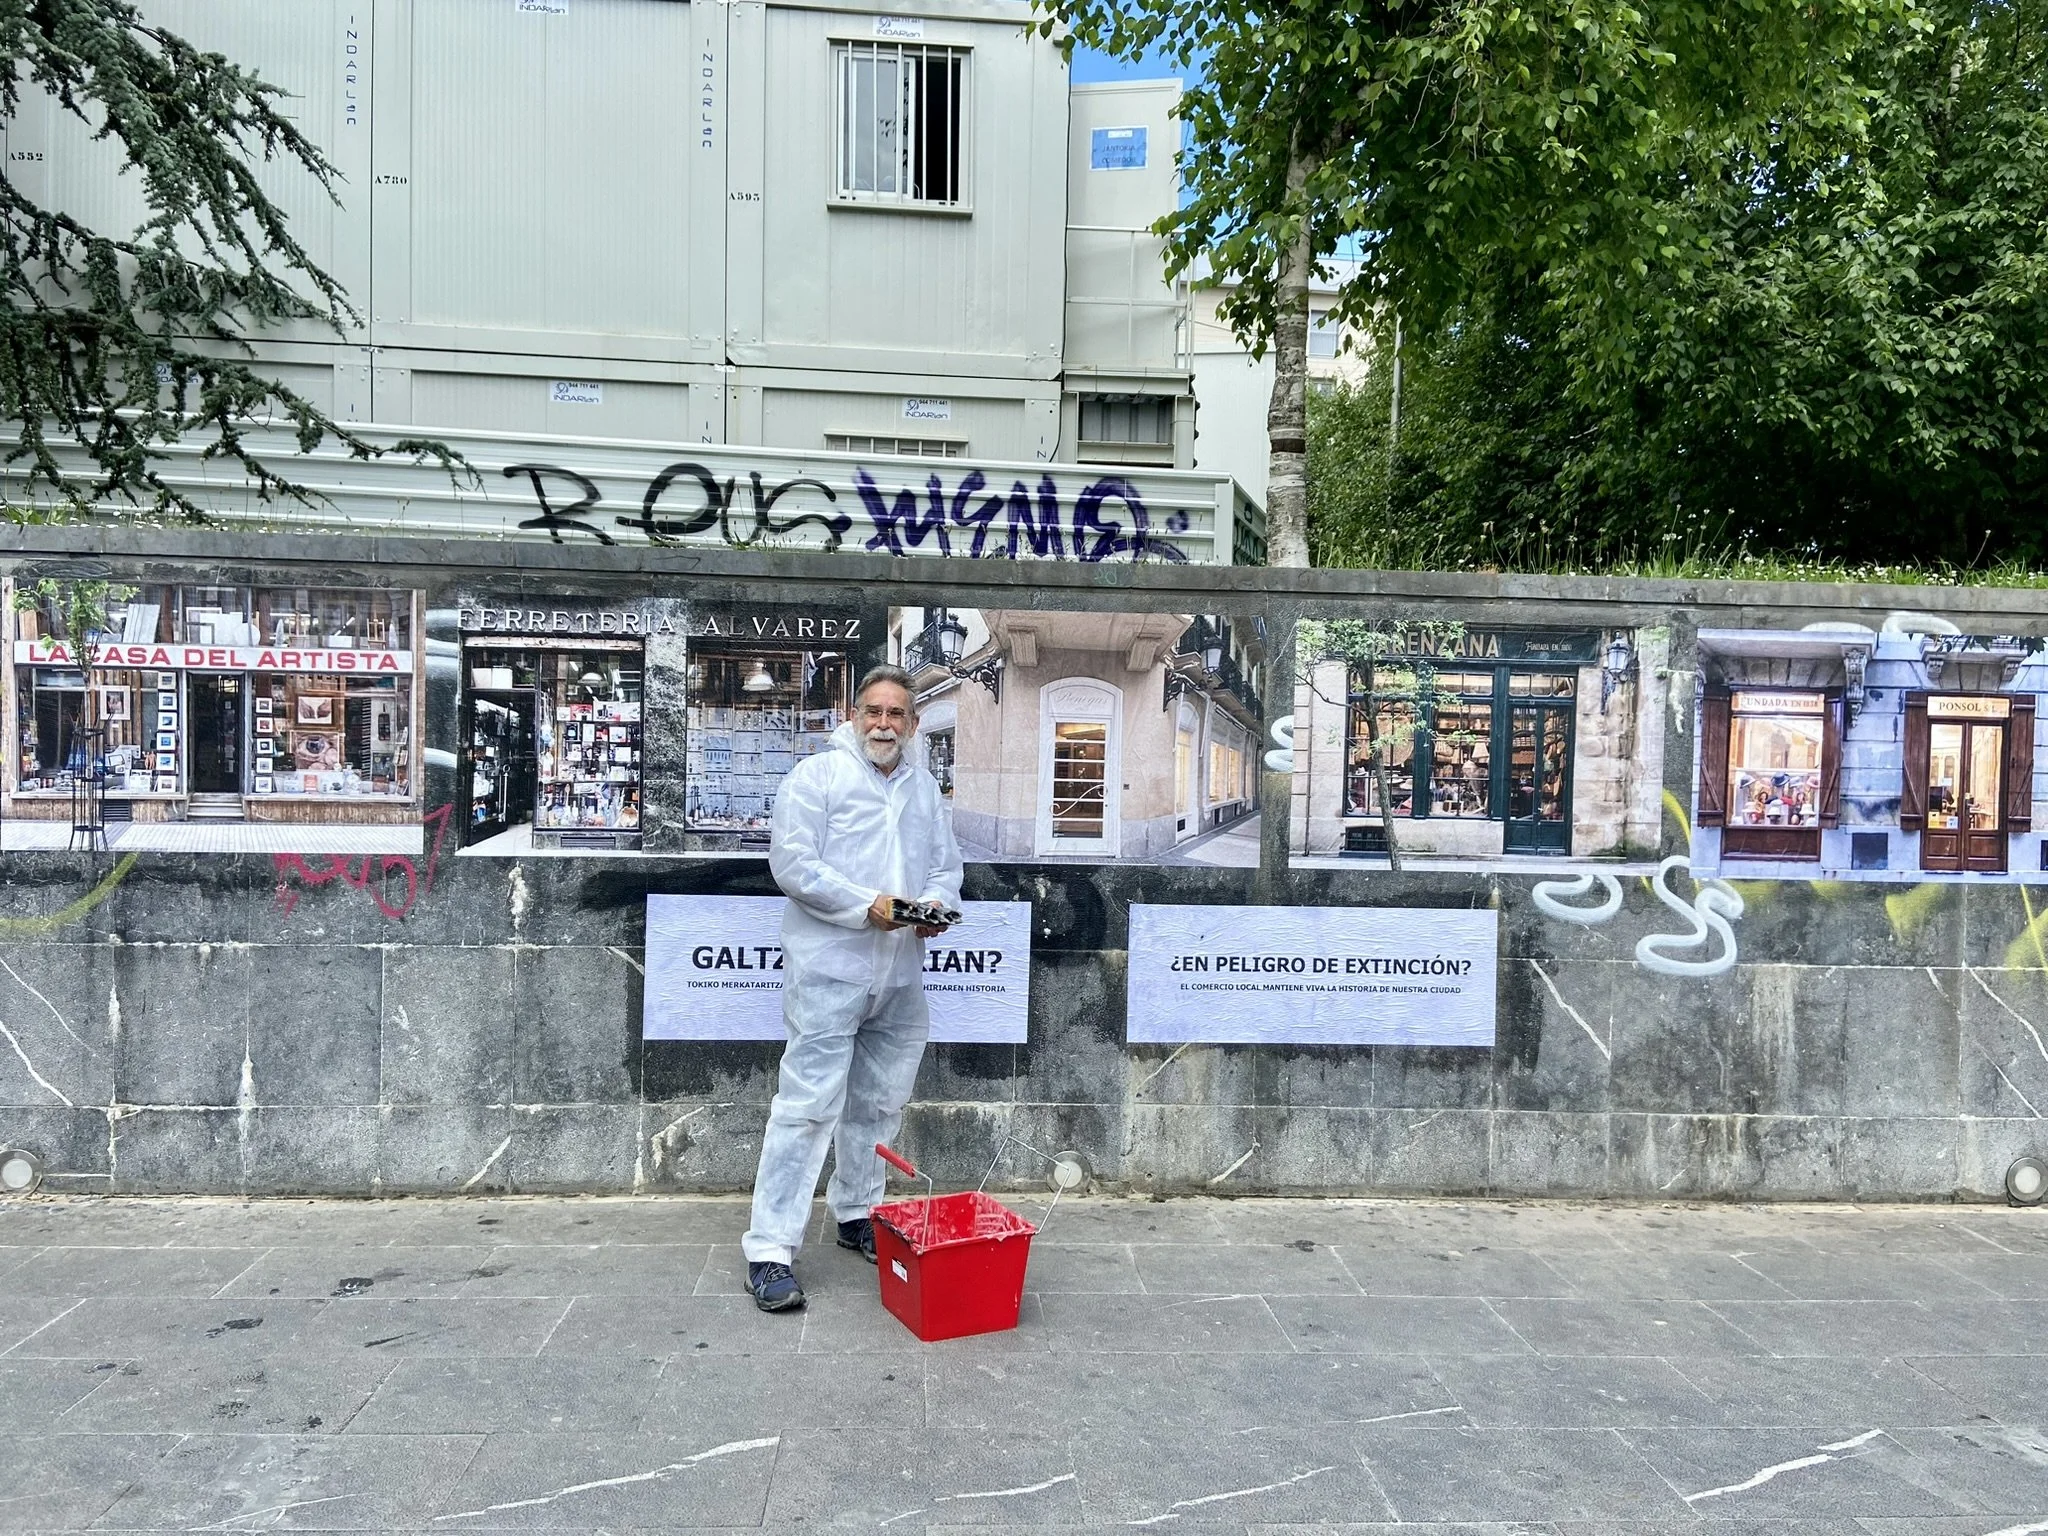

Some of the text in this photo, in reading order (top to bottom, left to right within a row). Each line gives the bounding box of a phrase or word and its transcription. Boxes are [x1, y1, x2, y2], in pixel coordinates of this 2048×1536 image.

[9, 151, 43, 161] A552
[457, 608, 861, 639] FERRETERIA ALVAREZ
[29, 643, 70, 663] LA
[184, 648, 247, 667] DEL
[257, 650, 399, 671] ARTISTA
[1939, 701, 1982, 713] PONSOL
[692, 945, 1003, 974] GALTZ IAN?
[1171, 954, 1472, 976] ¿EN PELIGRO DE EXTINCIÓN?
[687, 980, 719, 988] TOKIKO
[923, 984, 1006, 993] HIRIAREN HISTORIA
[1191, 983, 1234, 991] COMERCIO
[1235, 983, 1260, 991] LOCAL
[1262, 984, 1304, 992] MANTIENE
[1306, 984, 1325, 992] VIVA
[1338, 985, 1378, 993] HISTORIA
[1430, 986, 1461, 994] CIUDAD
